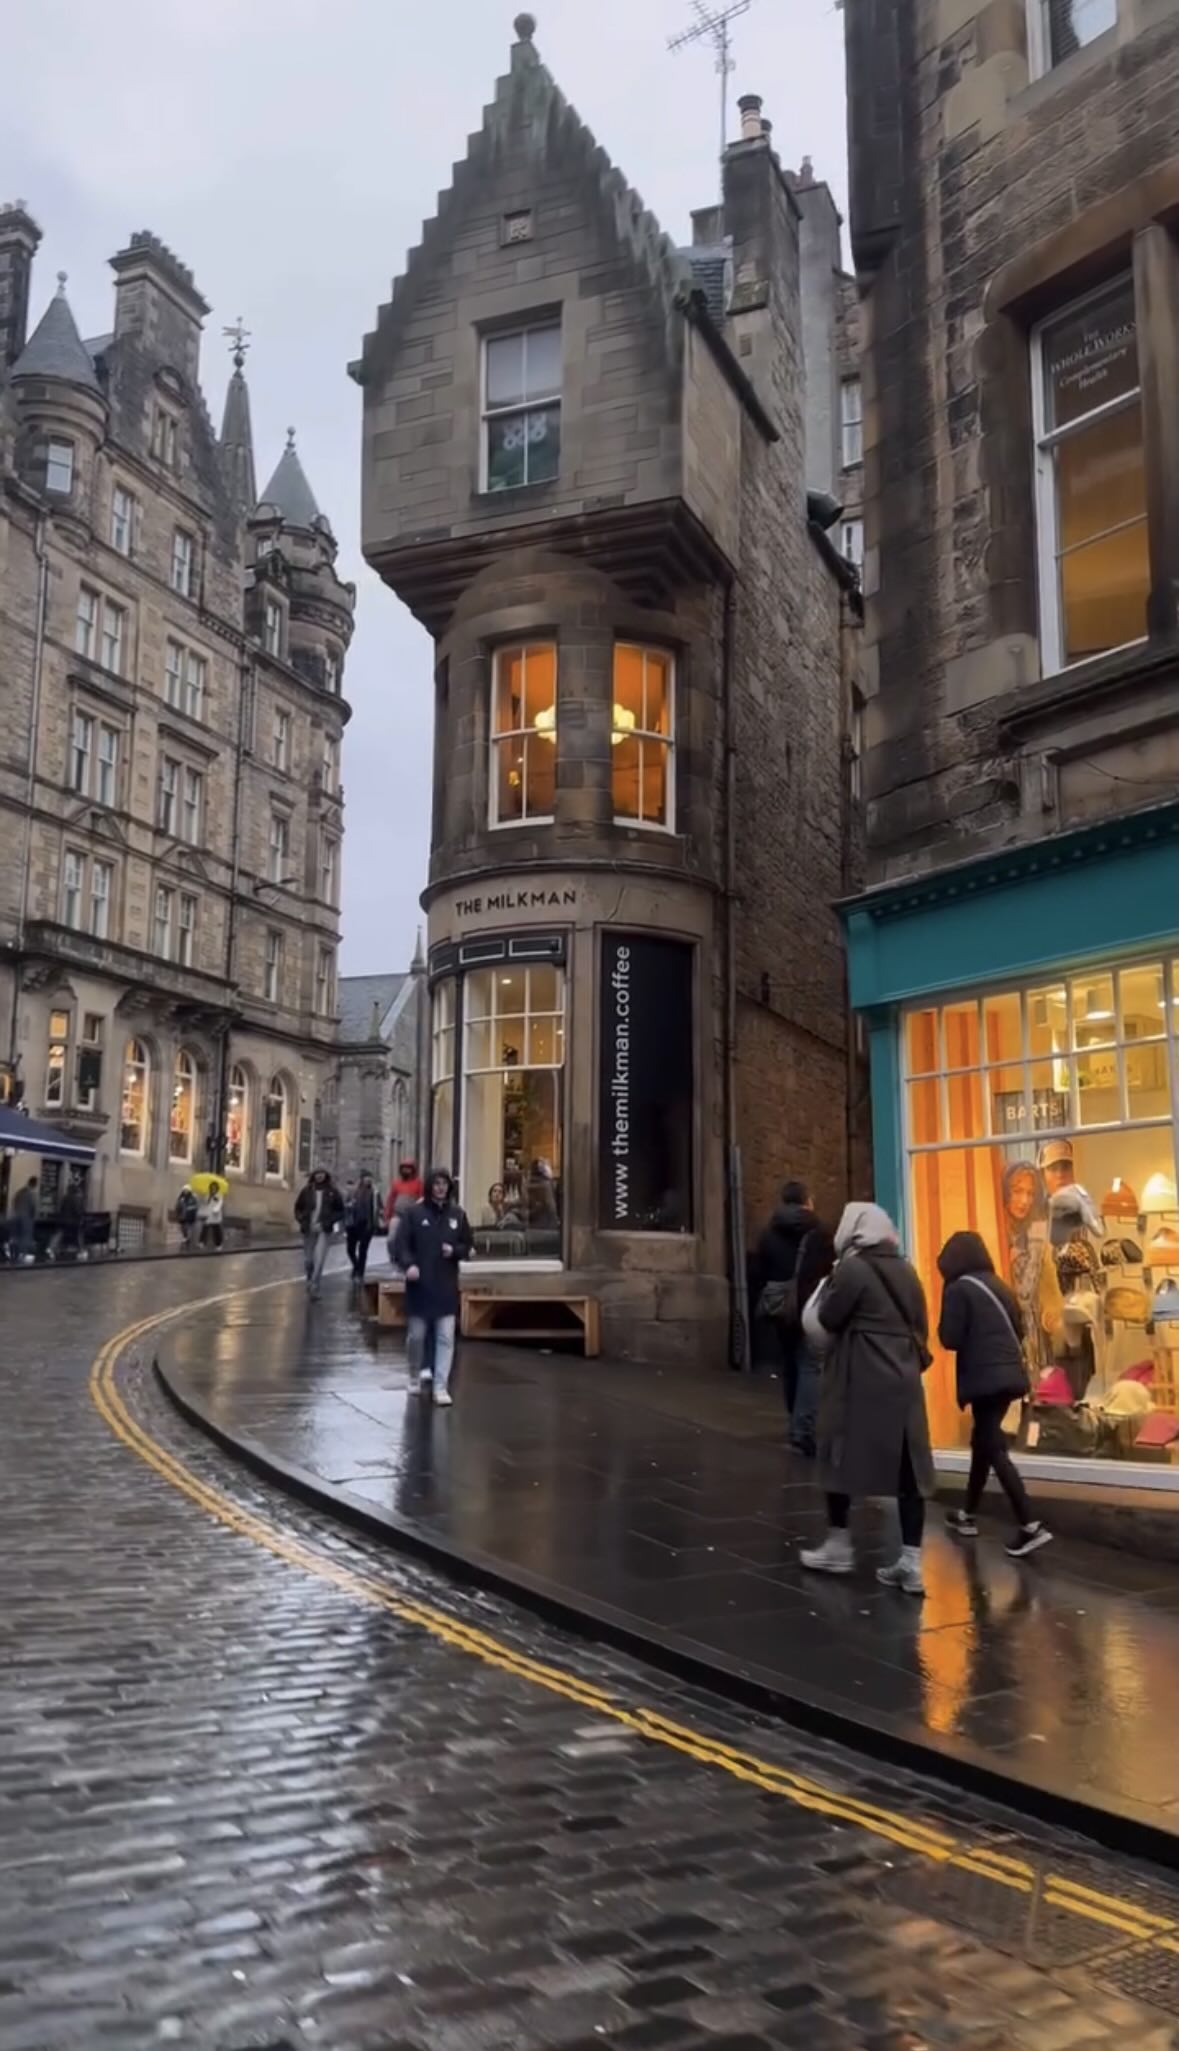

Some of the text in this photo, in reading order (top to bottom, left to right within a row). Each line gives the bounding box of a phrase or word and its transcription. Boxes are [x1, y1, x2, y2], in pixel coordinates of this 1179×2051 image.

[456, 890, 576, 917] THE MILKMAN
[611, 946, 631, 1156] themilkman.coffee
[1005, 1102, 1059, 1121] BARTS
